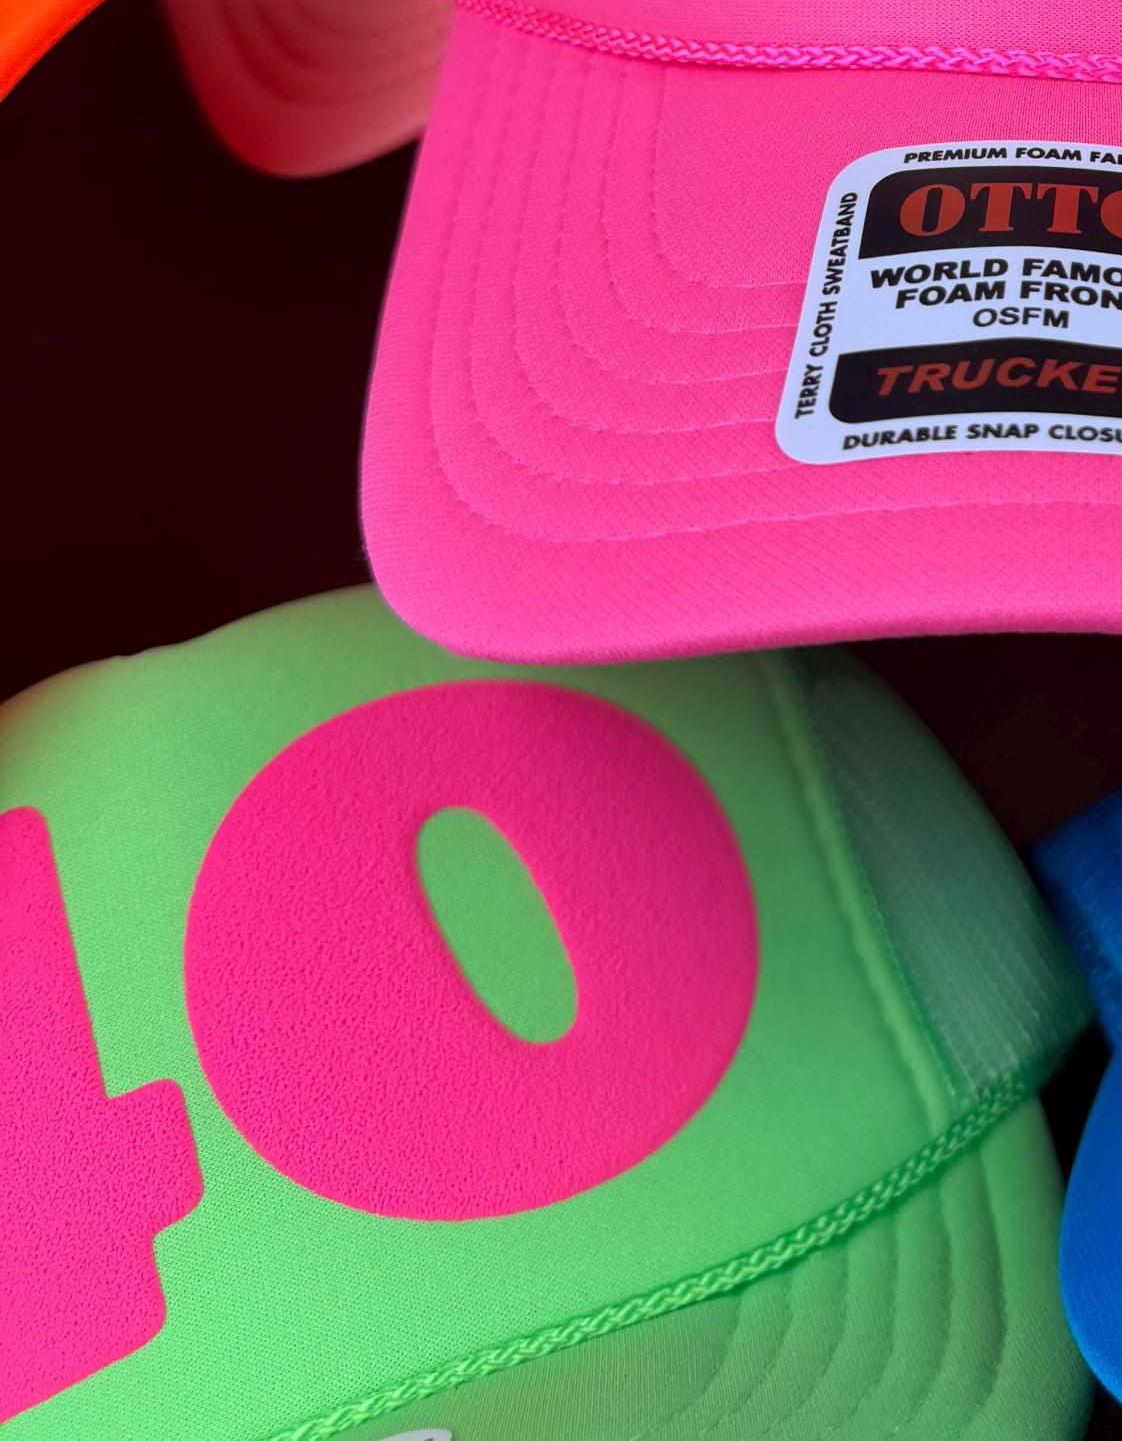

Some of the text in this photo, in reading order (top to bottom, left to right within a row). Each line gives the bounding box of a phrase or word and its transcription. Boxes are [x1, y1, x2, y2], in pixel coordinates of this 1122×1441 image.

[903, 147, 1007, 164] PREMIUM
[1015, 147, 1082, 161] FOAM
[870, 258, 1008, 289] WORLD
[795, 191, 858, 419] TERRY CLOTH SWEATBAND
[895, 281, 1006, 309] FOAM
[972, 306, 1070, 329] OSFM
[842, 424, 958, 450] DURABLE
[966, 423, 1040, 440] SNAP
